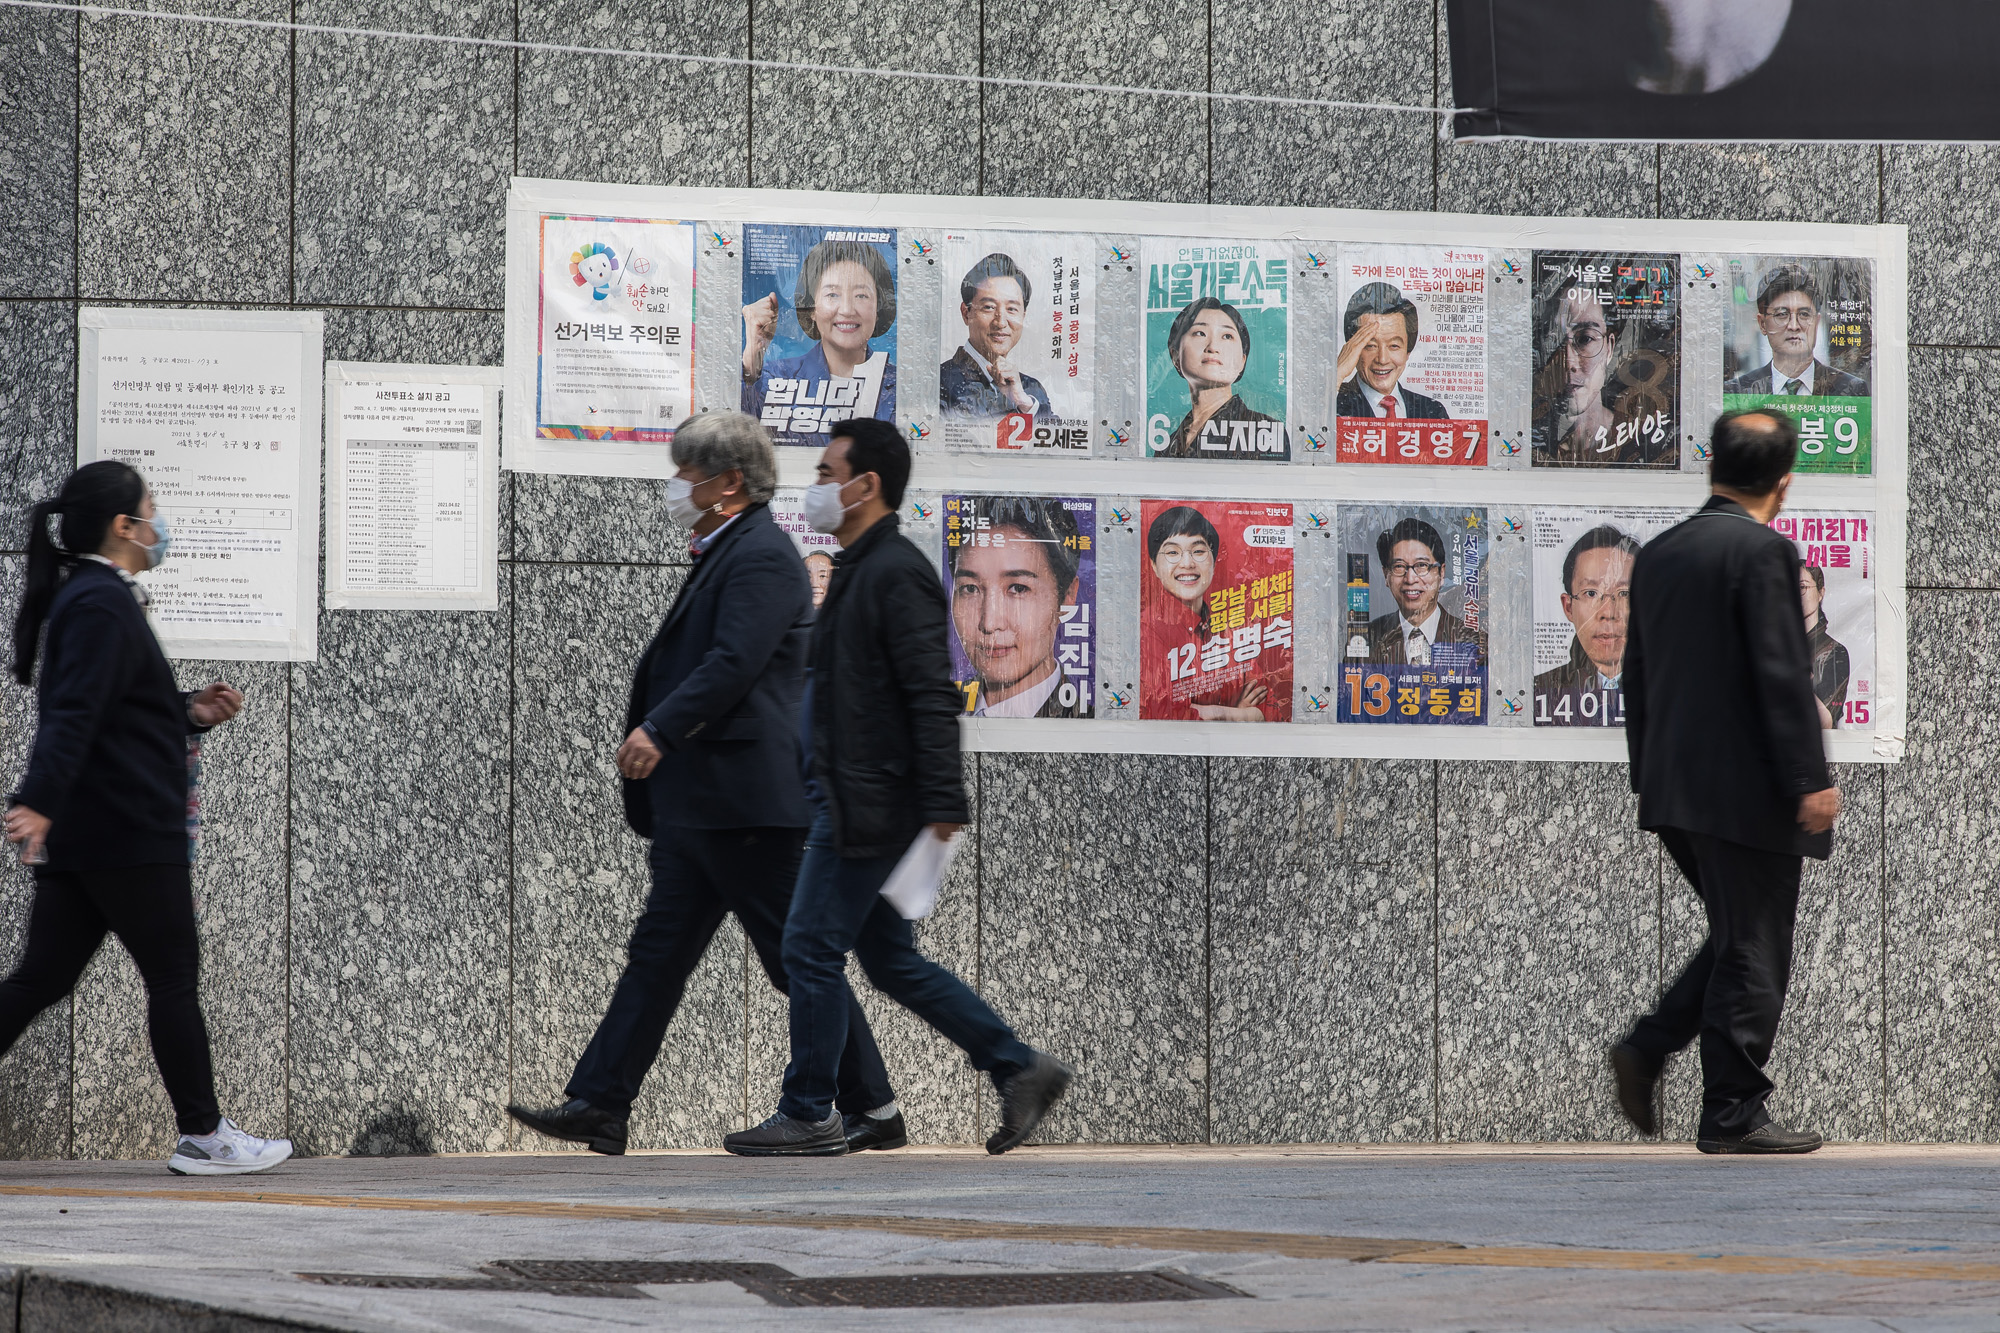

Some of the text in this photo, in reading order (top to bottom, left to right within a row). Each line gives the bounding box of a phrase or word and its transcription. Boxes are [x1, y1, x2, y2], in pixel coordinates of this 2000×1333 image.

[824, 231, 890, 243] 서울시 대전환
[1351, 266, 1484, 280] 국가에 돈이 없는 것이 아니라
[1567, 265, 1613, 282] 서울은
[626, 283, 669, 298] 훼손하면
[1069, 266, 1080, 316] 서울부터
[1147, 260, 1287, 309] 서울기본소득
[1402, 280, 1484, 293] 도둑놈이 많습니다
[1416, 294, 1484, 304] 국가 미래를 내다보는
[1567, 288, 1614, 305] 이기는
[632, 300, 670, 314] 안 돼요!
[1051, 257, 1063, 360] 첫날부터 능숙하게
[1430, 304, 1484, 313] 허경영이 옳았다!
[1435, 314, 1441, 322] 그
[1443, 314, 1465, 323] 나물에
[1467, 315, 1474, 323] 그
[554, 322, 682, 345] 선거벽보 주의문
[1436, 324, 1484, 333] 이제 끝냅시다.
[1830, 325, 1862, 335] 서민 행복
[1419, 335, 1438, 343] 서울시
[1830, 336, 1862, 347] 서울 혁명
[112, 380, 286, 395] 선거인명부 열람 및 등재여부 확인기간 등 공고
[765, 352, 890, 418] 합니다 1
[376, 391, 450, 401] 사전투표소 설치 공고
[1789, 404, 1796, 412] 첫
[1797, 405, 1817, 413] 주창자,
[1819, 405, 1844, 414] 제3정치
[1845, 406, 1858, 414] 대표
[1008, 415, 1027, 447] 2
[1036, 418, 1089, 427] 서울특별시장후보
[1033, 428, 1089, 450] 오세훈
[1148, 414, 1285, 453] 6 신지혜
[1594, 410, 1671, 454] 오태양
[1834, 416, 1859, 454] 9
[1462, 432, 1482, 460] 7
[946, 500, 976, 514] 여자
[1062, 502, 1092, 511] 여성의당
[1266, 508, 1288, 517] 진보당
[946, 515, 991, 530] 혼자도
[1802, 518, 1868, 542] 자리가
[946, 532, 1092, 550] 살기좋은 서울
[1252, 536, 1286, 545] 지지후보
[1452, 534, 1462, 586] 3시 정동희
[1210, 569, 1293, 612] 강남 해체!
[1210, 593, 1292, 634] 평등 서울!
[1167, 617, 1292, 682] 12 송명숙
[1058, 604, 1091, 714] 김진아
[955, 680, 980, 712] 1
[1346, 673, 1391, 716] 13
[1536, 691, 1626, 727] 14 이
[1845, 700, 1869, 724] 15
